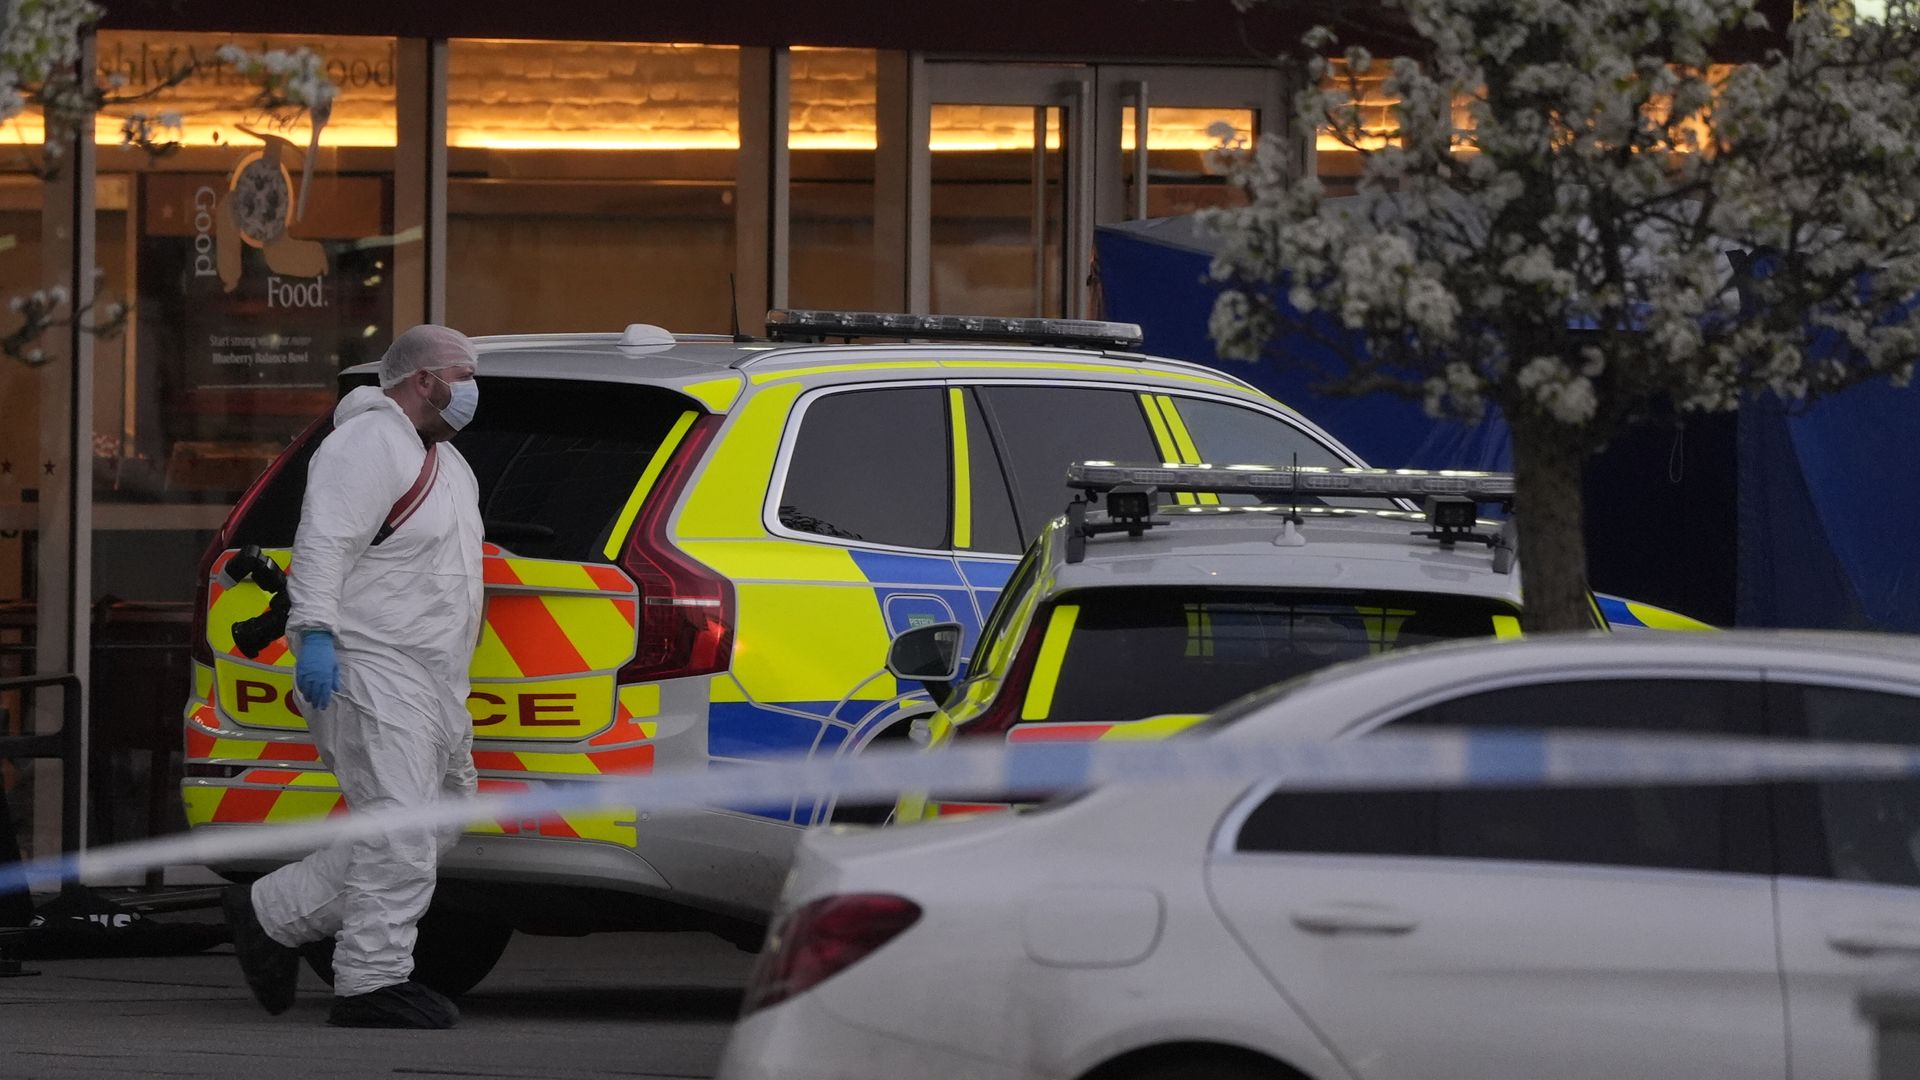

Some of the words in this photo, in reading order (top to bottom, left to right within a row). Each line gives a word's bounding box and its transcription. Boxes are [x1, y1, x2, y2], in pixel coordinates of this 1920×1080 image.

[195, 186, 217, 275] Good
[267, 275, 329, 308] Food.
[212, 352, 253, 367] Blueberry
[255, 352, 287, 364] Balance
[288, 351, 309, 363] Bowl
